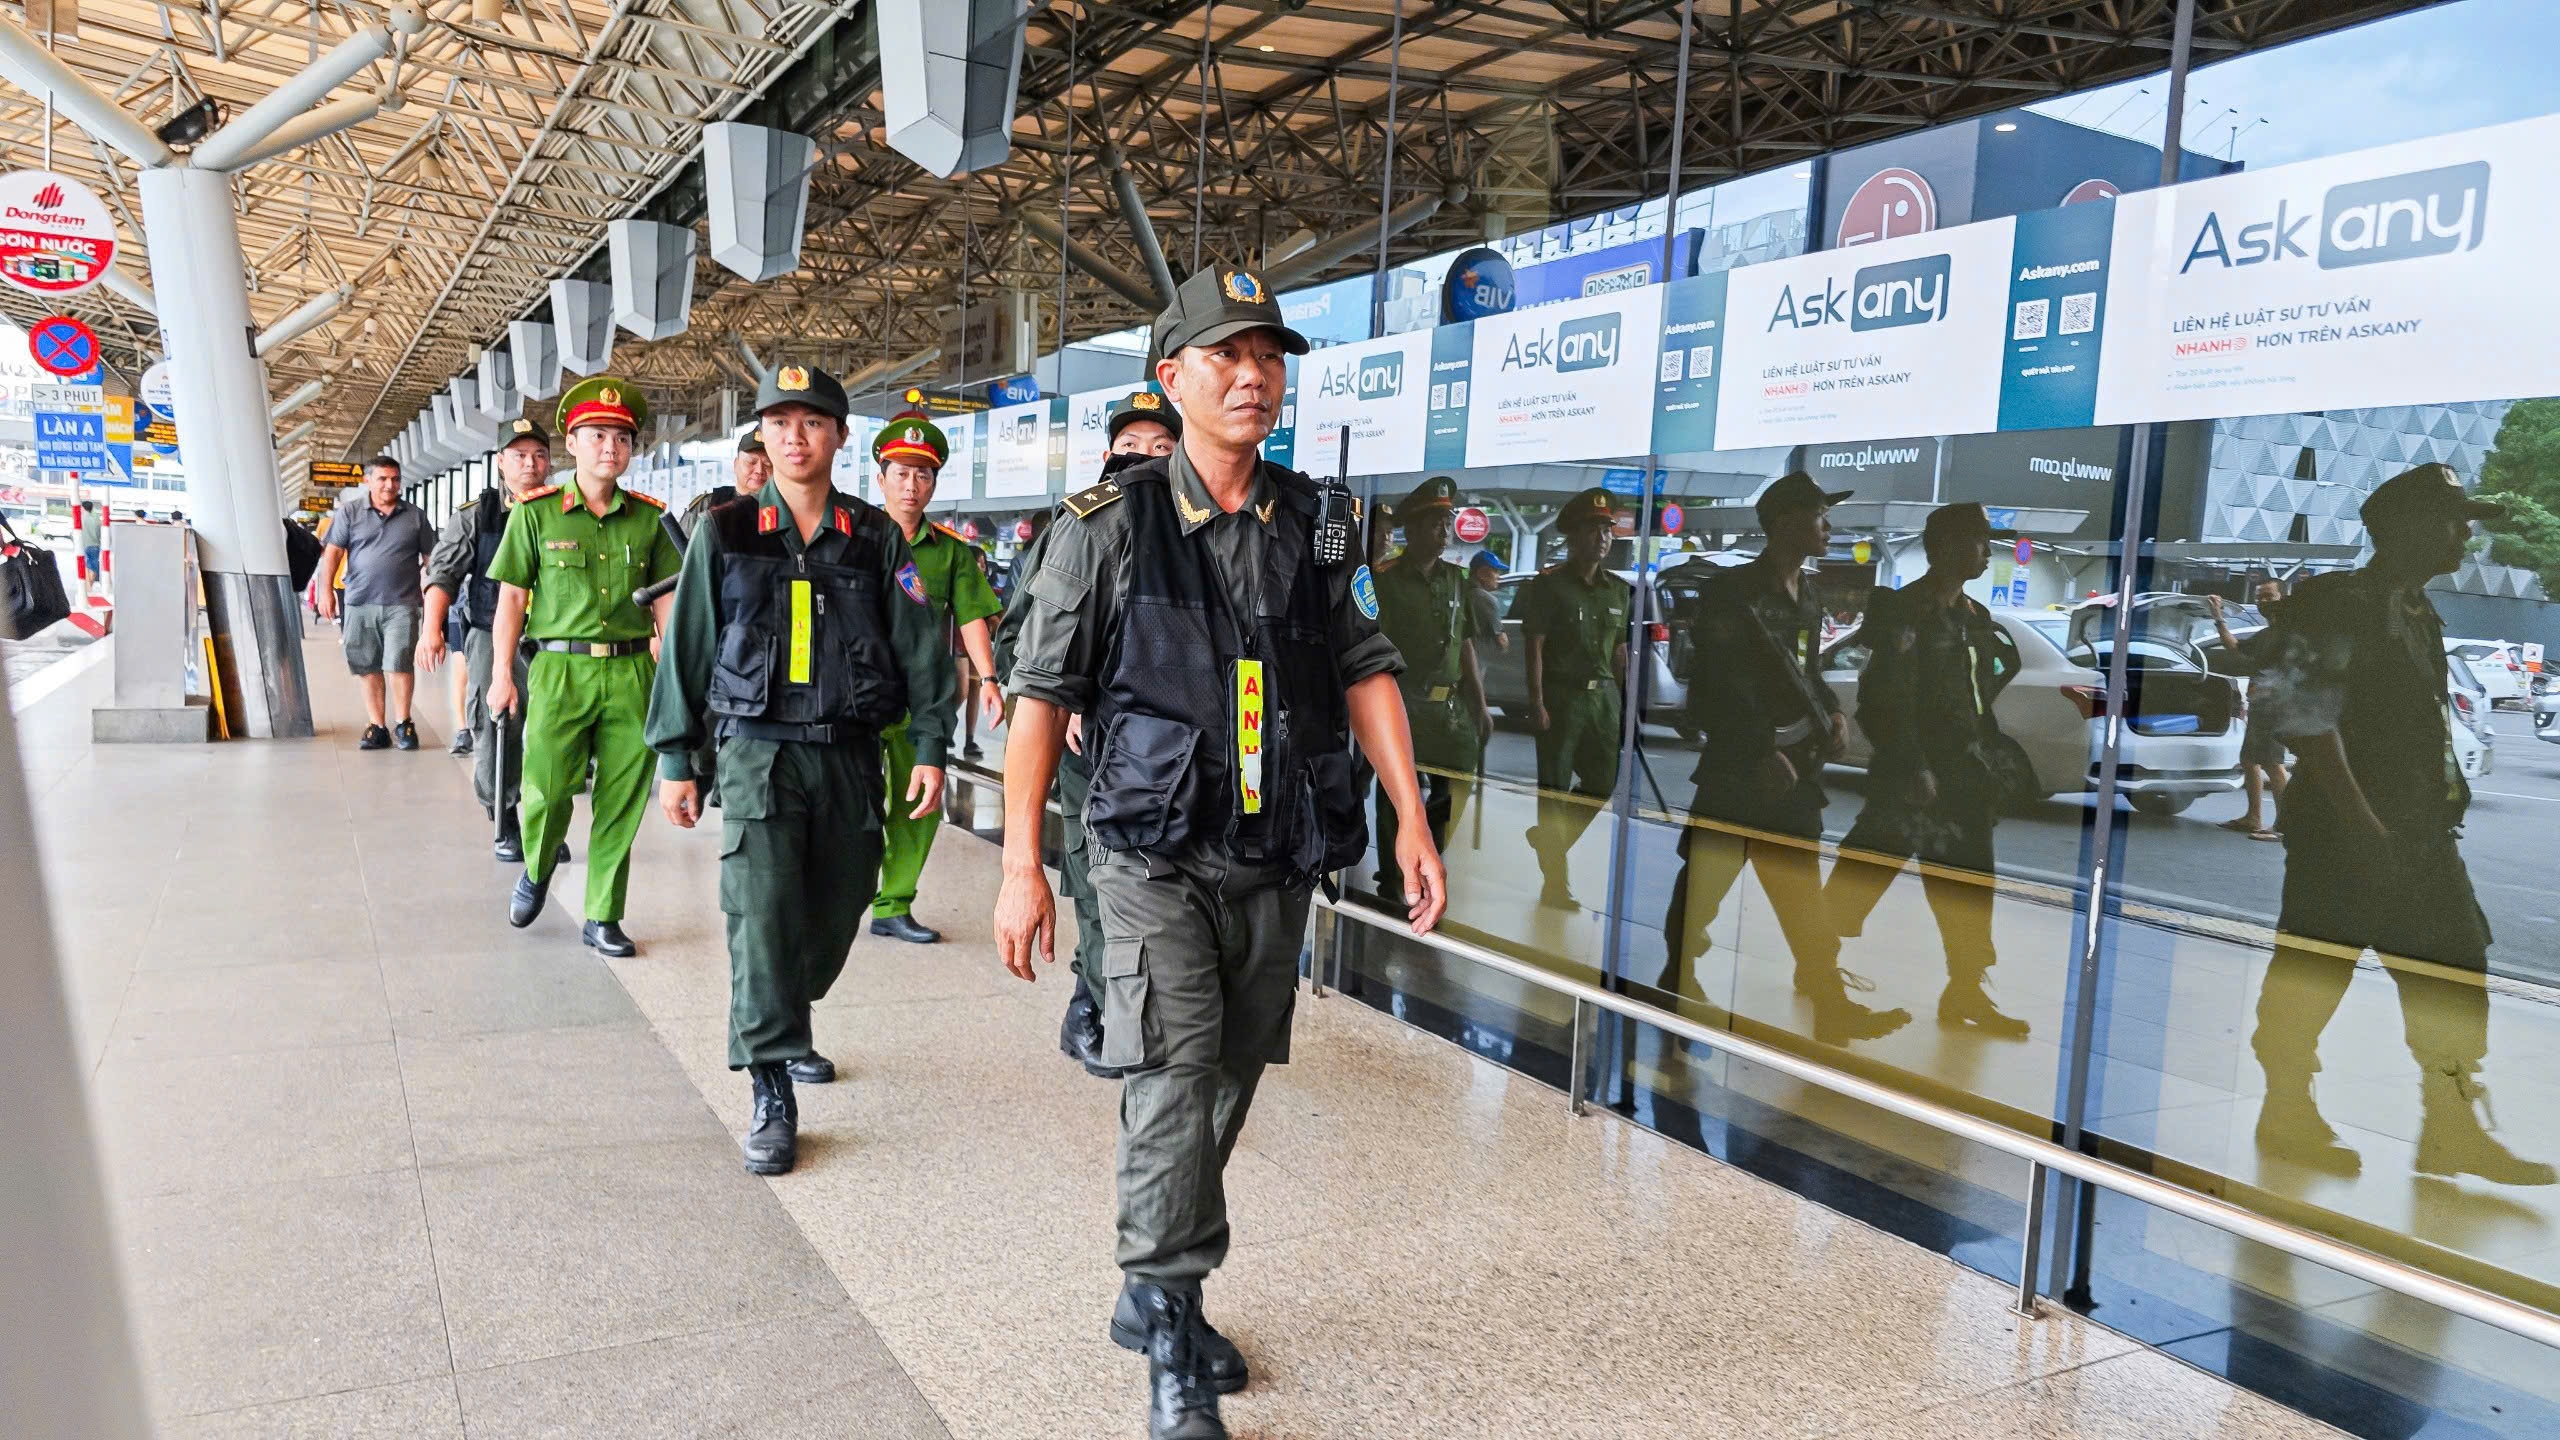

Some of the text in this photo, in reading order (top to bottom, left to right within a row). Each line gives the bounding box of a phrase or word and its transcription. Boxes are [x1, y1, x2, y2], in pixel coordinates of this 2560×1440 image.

[6, 207, 85, 226] Dongtam
[41, 237, 96, 256] NƯỚC
[2019, 260, 2100, 281] Askany.com
[2173, 295, 2371, 333] LIÊN HỆ LUẬT SƯ TƯ VẤN
[2175, 319, 2422, 356] NHANH HƠN TRÊN ASKANY
[1763, 368, 1783, 379] LIÊN
[1800, 362, 1825, 376] LUẬT
[1838, 376, 1865, 389] TRÊN
[1867, 372, 1912, 386] ASKANY
[52, 390, 59, 400] 3
[43, 415, 78, 436] LÀN
[82, 421, 95, 436] A
